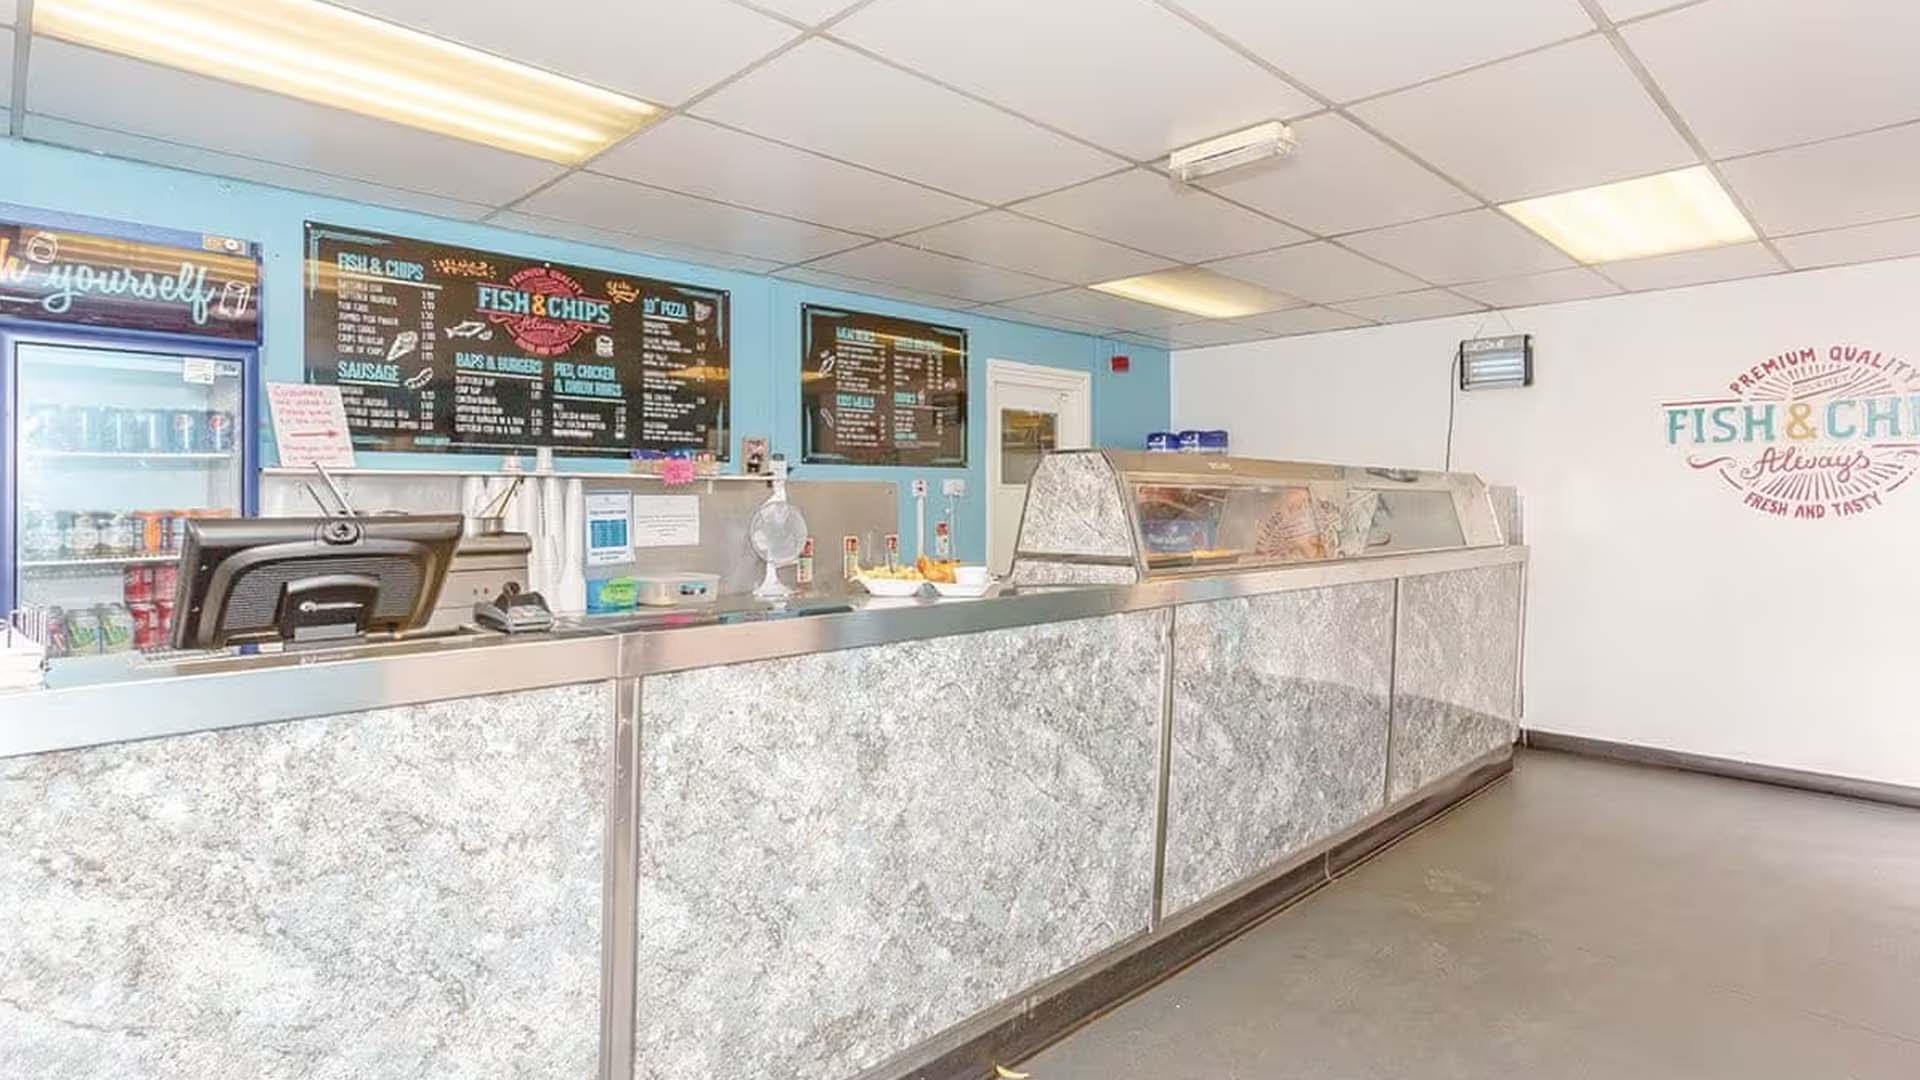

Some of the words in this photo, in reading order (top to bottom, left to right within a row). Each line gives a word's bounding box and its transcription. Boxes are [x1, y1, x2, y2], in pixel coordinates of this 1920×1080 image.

[337, 252, 369, 272] FISH
[370, 257, 384, 276] &
[386, 259, 424, 281] CHIPS
[41, 262, 215, 325] yourself
[477, 287, 530, 314] FISH
[532, 294, 546, 317] &
[548, 296, 612, 325] CHIPS
[337, 360, 399, 380] SAUSAGE
[1729, 347, 1817, 395] PREMIUM
[1829, 345, 1920, 384] QUALITY
[1666, 403, 1777, 445] FISH
[1786, 402, 1818, 441] &
[1740, 446, 1871, 484] Always
[1743, 491, 1788, 517] FRESH
[1794, 505, 1826, 520] AND
[1832, 490, 1883, 518] TASTY
